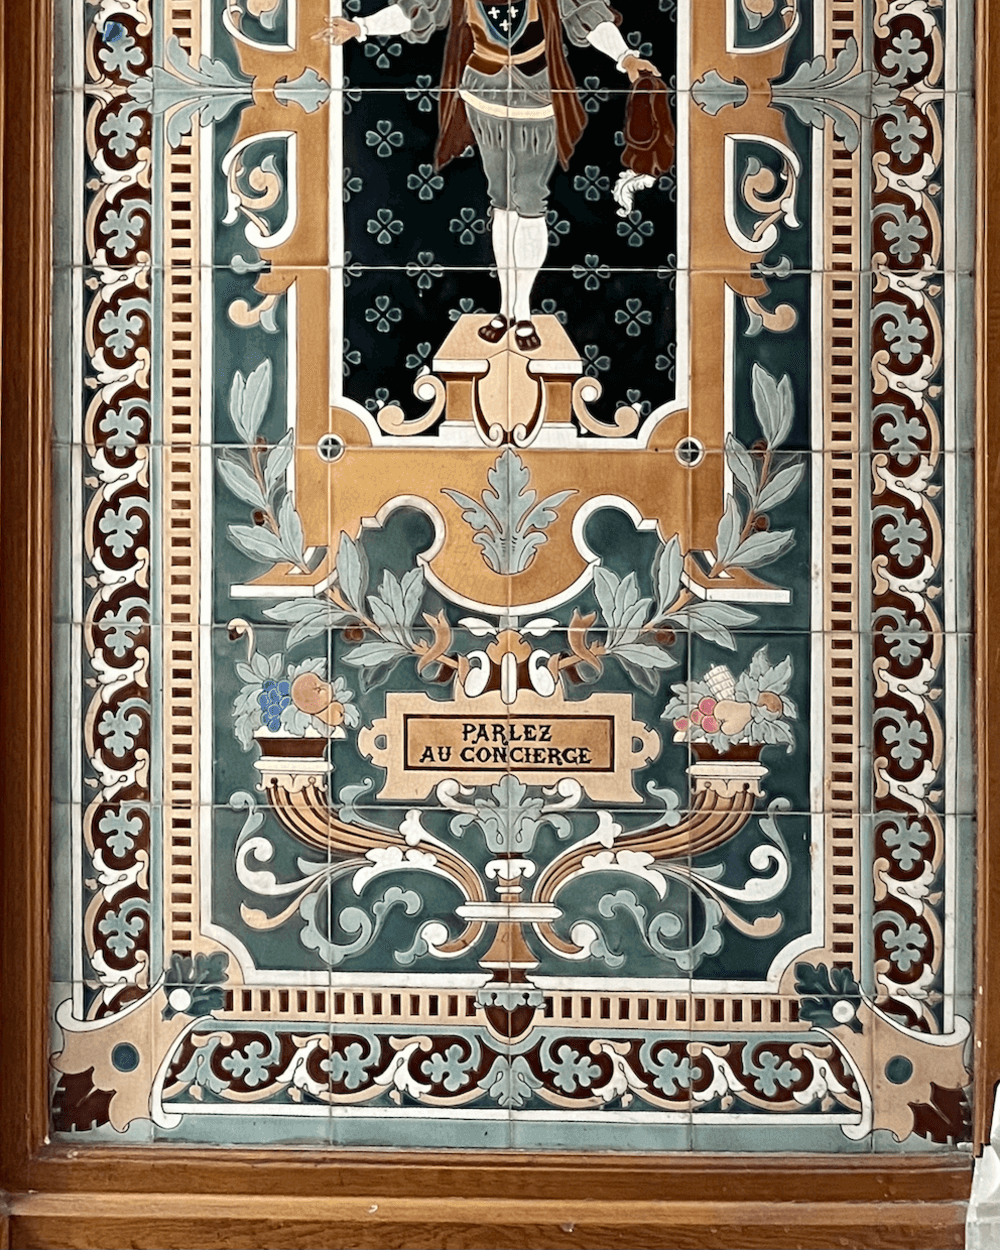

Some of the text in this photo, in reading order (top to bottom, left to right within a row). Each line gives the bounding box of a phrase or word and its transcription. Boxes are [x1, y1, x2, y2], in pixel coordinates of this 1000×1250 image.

[462, 723, 552, 745] PARLEZ
[419, 746, 592, 765] AU CONCIERGE
